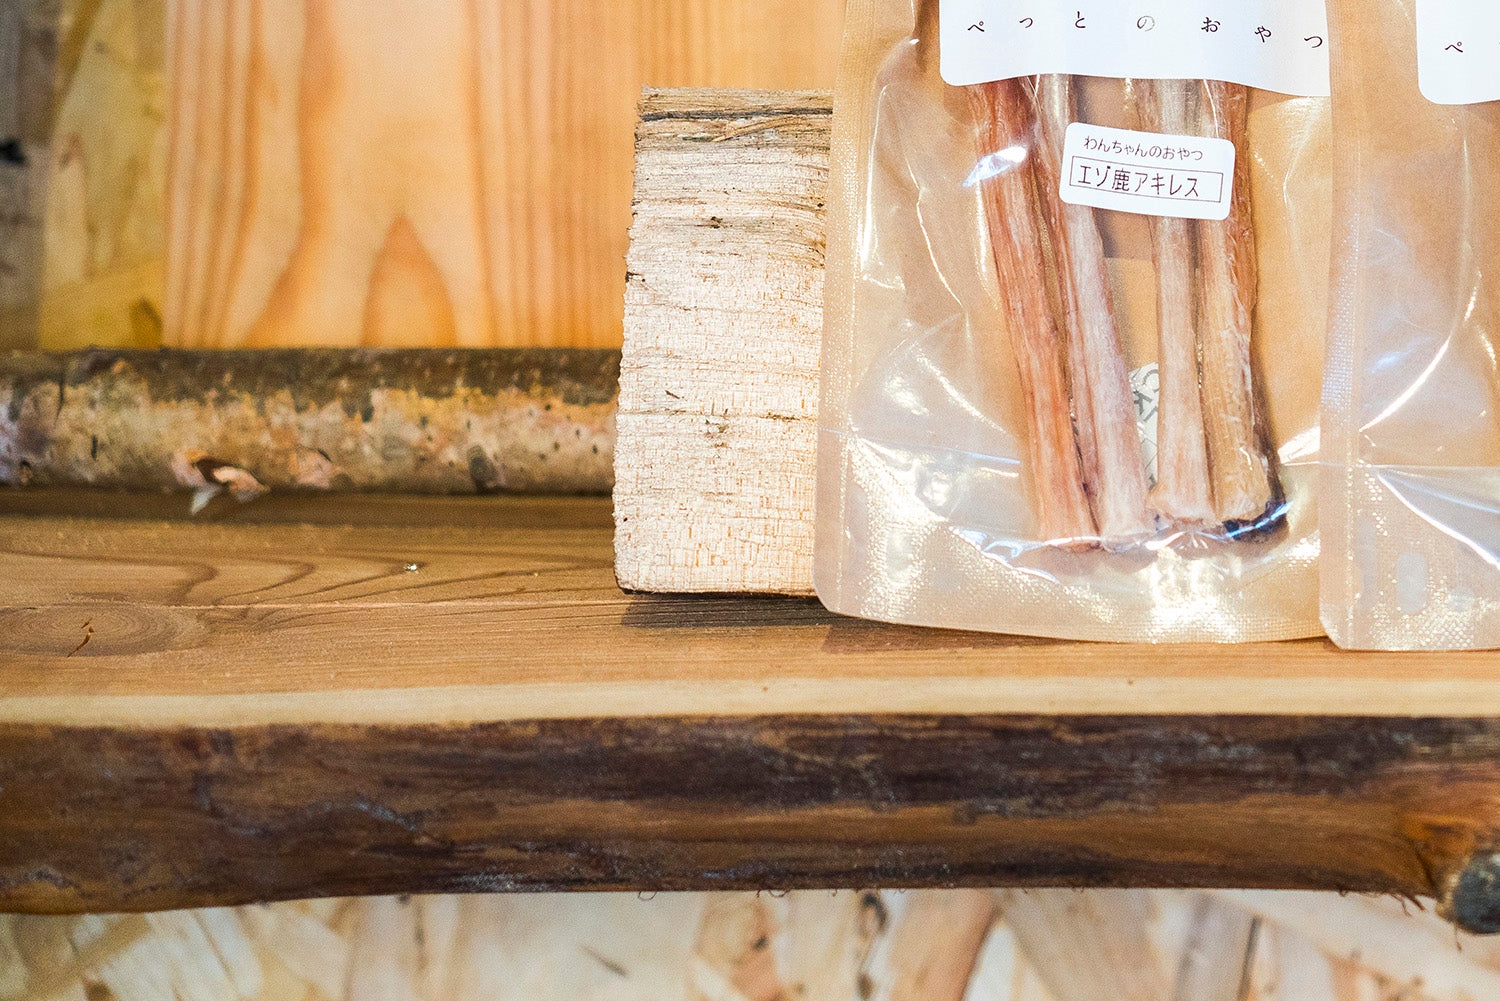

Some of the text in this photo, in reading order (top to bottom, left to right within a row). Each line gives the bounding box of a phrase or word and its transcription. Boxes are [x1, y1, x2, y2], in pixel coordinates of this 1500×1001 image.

[1083, 135, 1204, 161] わんちゃんのおやつ
[1077, 165, 1199, 197] エゾ鹿アキレス
